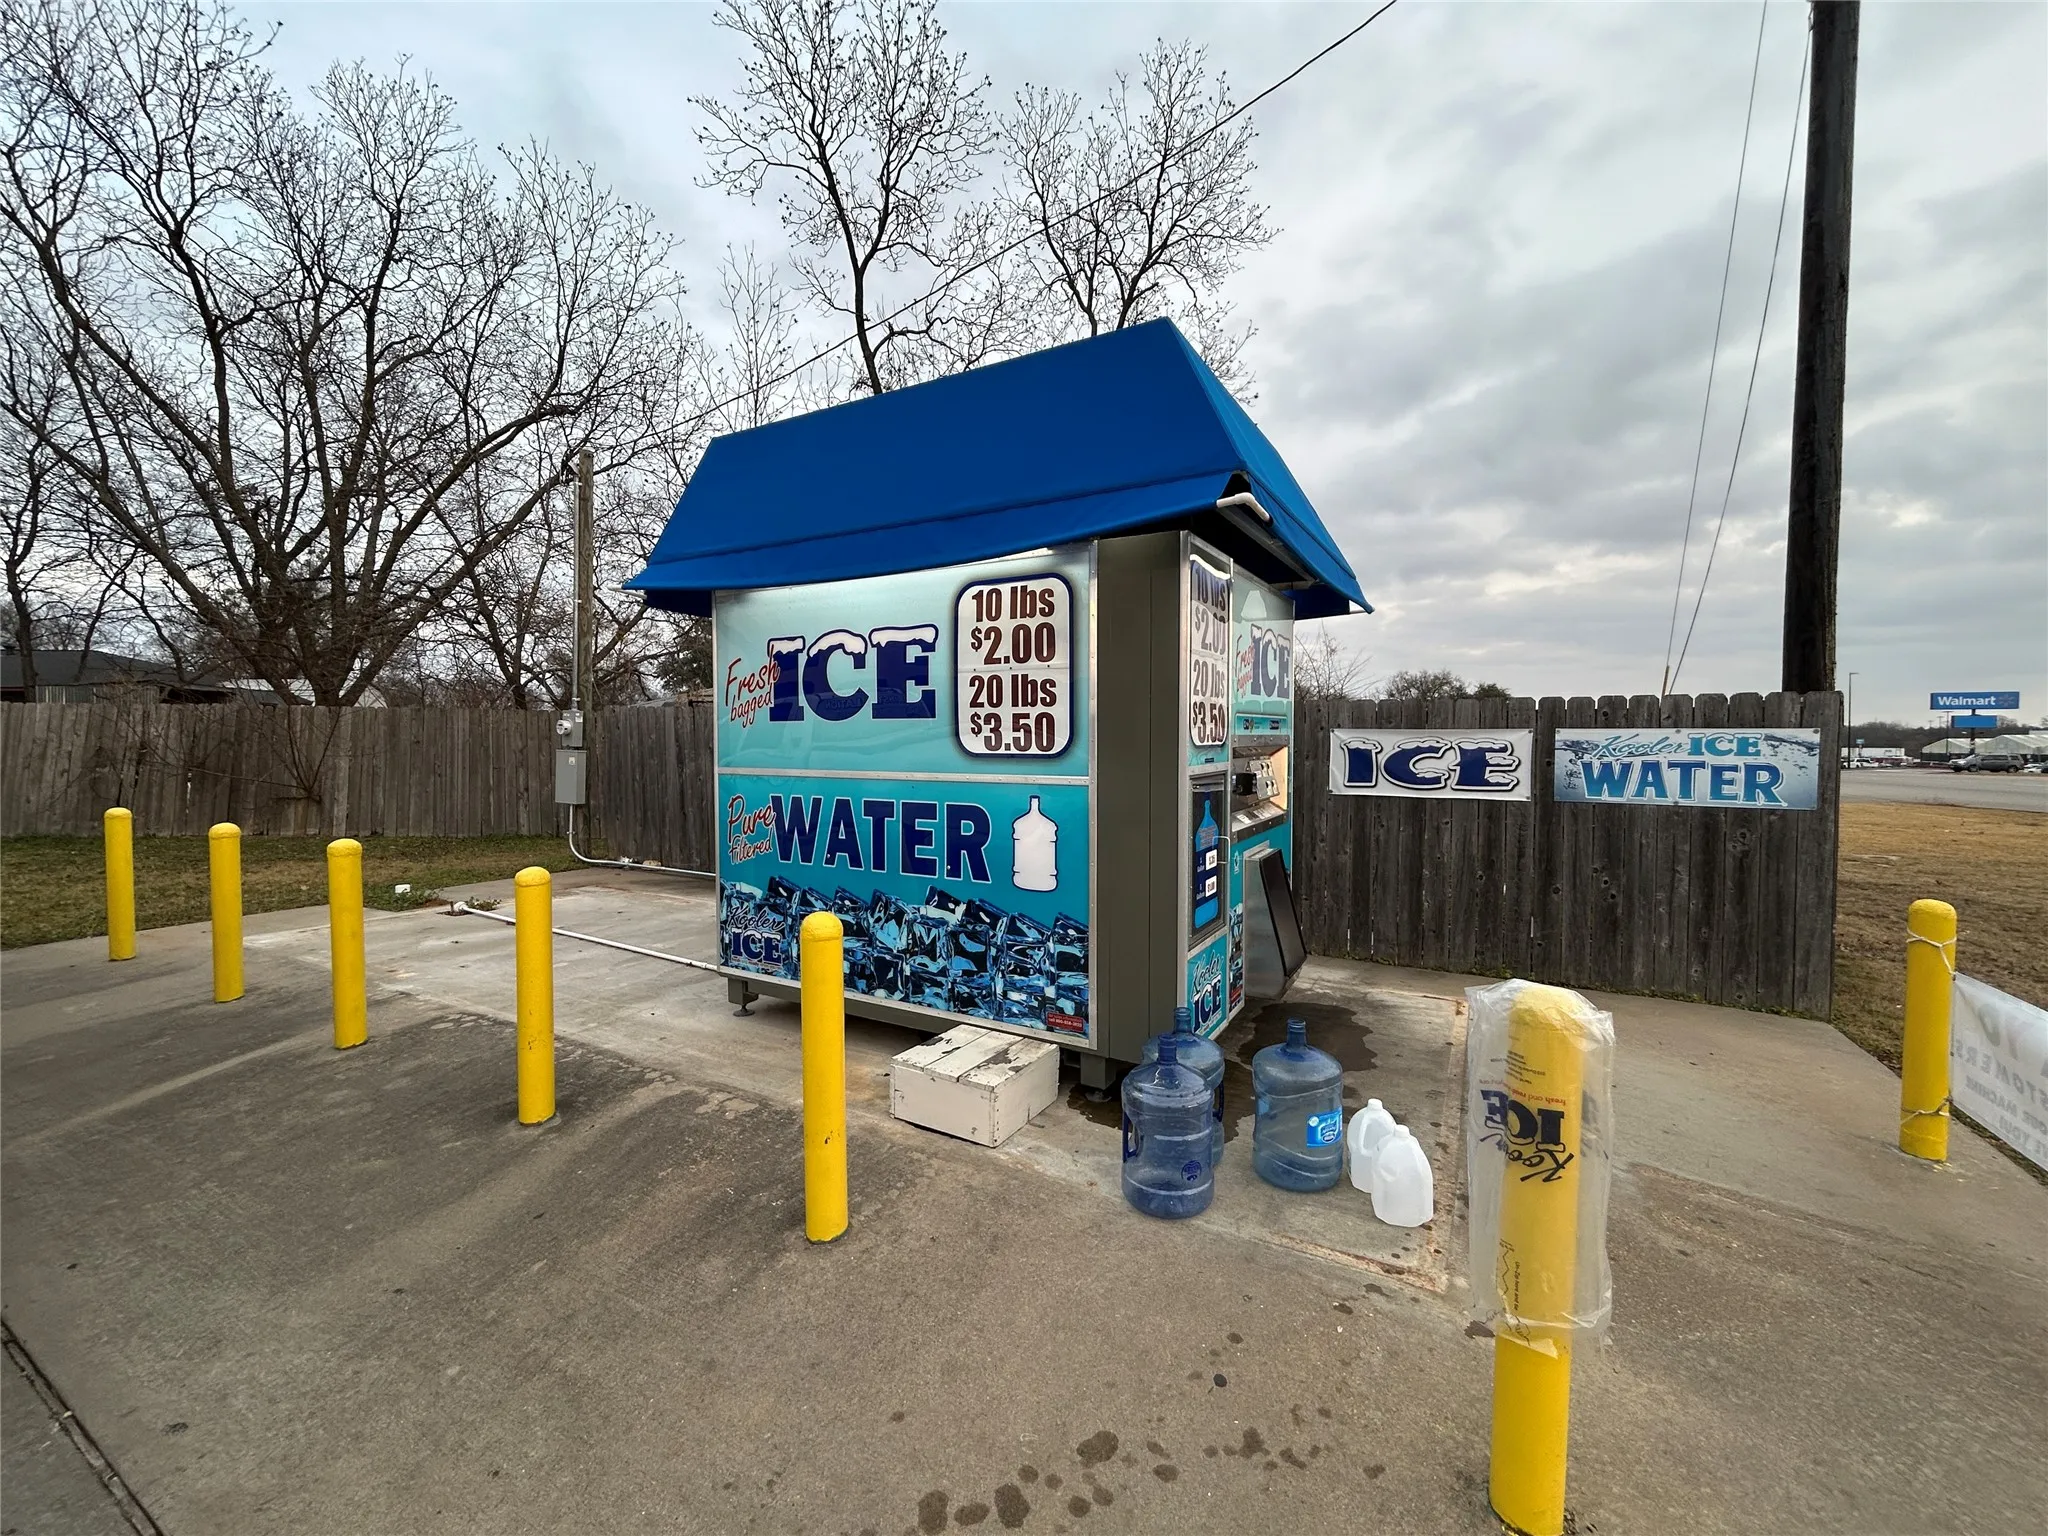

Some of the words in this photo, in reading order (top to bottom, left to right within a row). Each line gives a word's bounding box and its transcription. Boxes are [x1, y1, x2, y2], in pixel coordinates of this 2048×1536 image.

[971, 587, 1001, 623] 10
[1010, 585, 1056, 620] lbs
[970, 622, 1057, 666] $2.00
[1250, 623, 1291, 700] ICE
[725, 643, 781, 707] Fresh
[767, 623, 939, 722] ICE
[969, 674, 1001, 709] 20
[1011, 673, 1057, 708] lbs
[1193, 659, 1209, 698] 20
[1210, 662, 1225, 700] lbs
[730, 682, 773, 729] bagged
[1192, 701, 1226, 744] $3.50
[1937, 695, 1997, 707] Walmart
[969, 711, 1056, 753] $3.50
[1593, 733, 1690, 758] Kooler
[1687, 732, 1765, 757] ICE
[1340, 736, 1521, 791] ICE
[1579, 759, 1788, 807] WATER
[727, 793, 777, 845] Pure
[769, 793, 992, 885] WATER
[727, 826, 773, 865] filtered
[727, 905, 787, 931] Kooler
[731, 927, 783, 965] ICE
[1190, 950, 1224, 999] Kooler
[1192, 972, 1222, 1032] ICE
[1527, 1093, 1543, 1102] and
[1545, 1096, 1566, 1106] fresh
[1480, 1089, 1566, 1153] ICE
